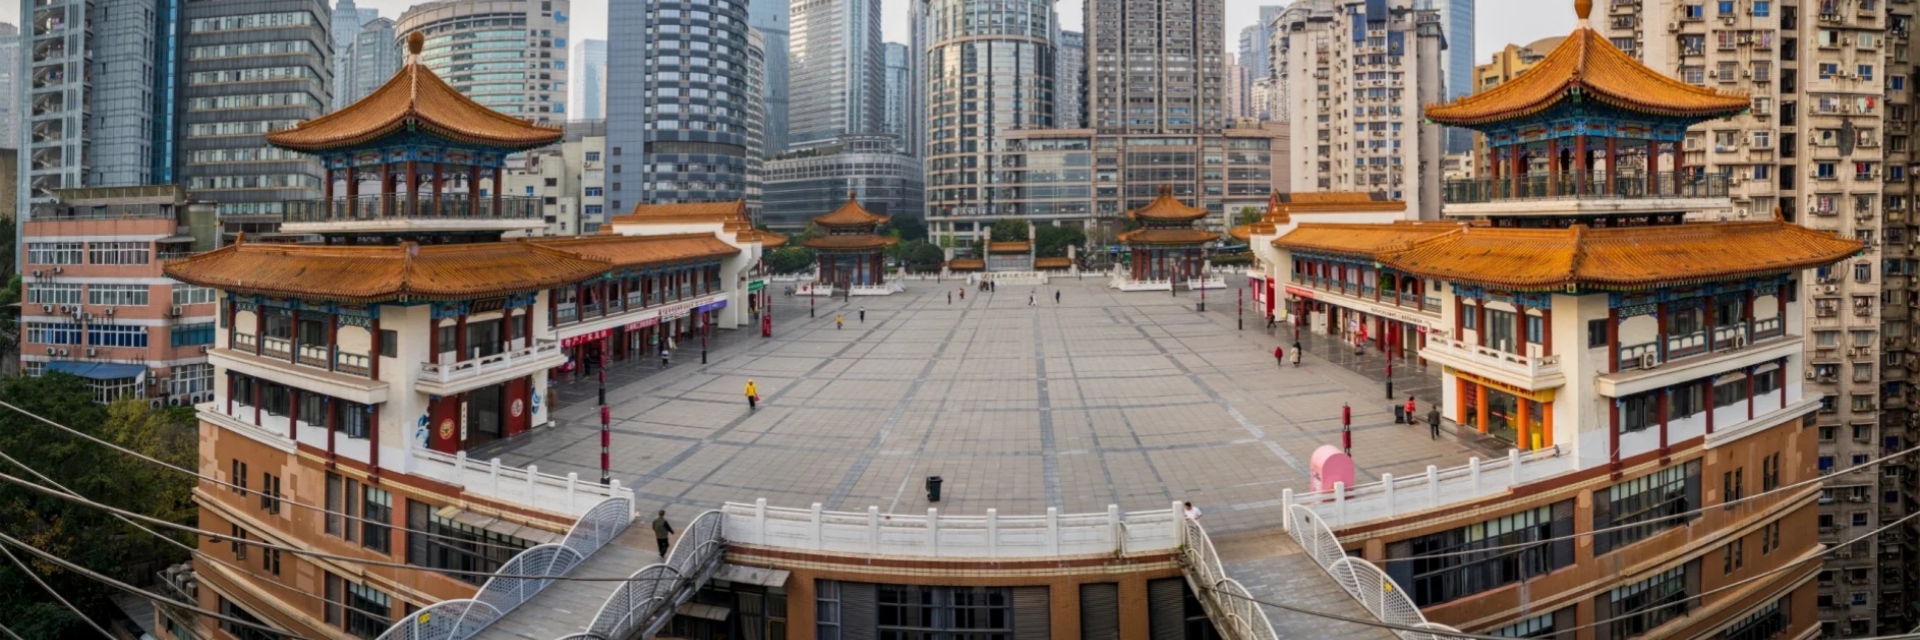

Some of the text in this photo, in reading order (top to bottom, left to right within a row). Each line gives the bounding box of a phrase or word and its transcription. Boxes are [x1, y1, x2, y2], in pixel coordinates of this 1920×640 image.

[561, 330, 607, 348] 特产厂家直销
